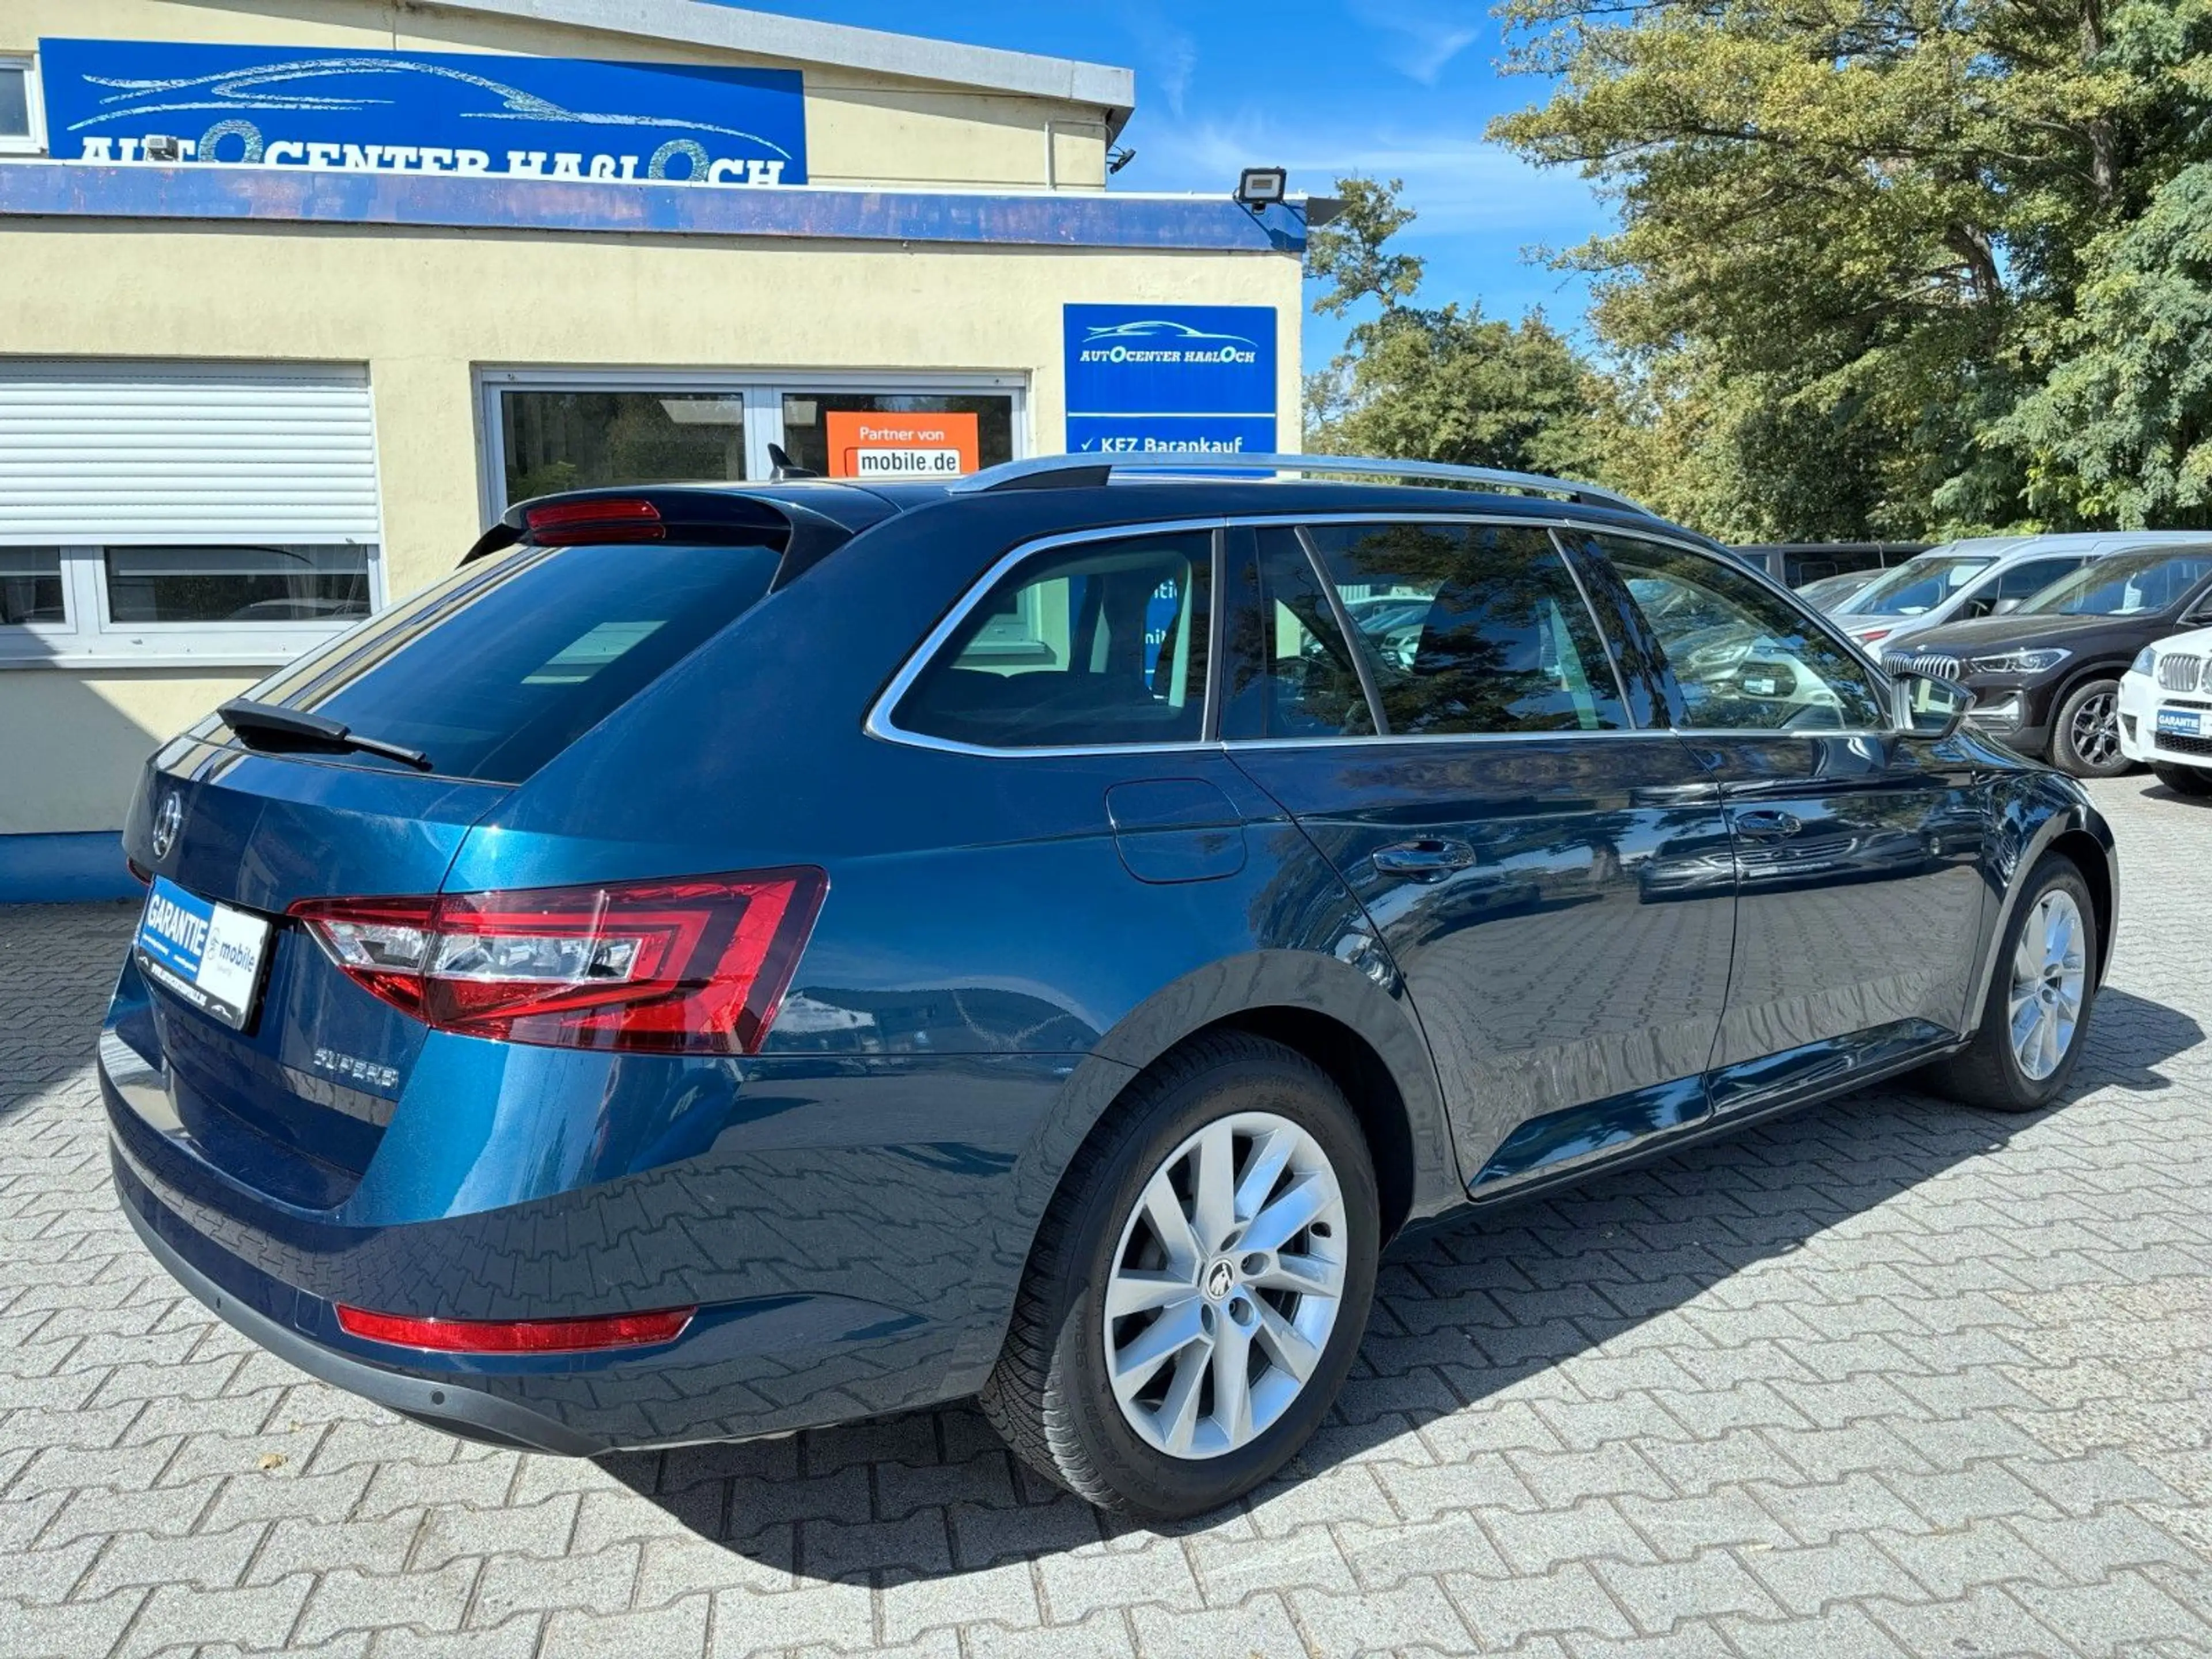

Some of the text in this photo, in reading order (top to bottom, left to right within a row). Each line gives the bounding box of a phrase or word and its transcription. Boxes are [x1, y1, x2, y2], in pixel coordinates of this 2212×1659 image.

[81, 119, 490, 172] ATOCENTER
[1080, 346, 1181, 363] AUTOCENTER
[860, 427, 944, 441] Partner von
[1101, 437, 1243, 453] KFZ Barankauf
[862, 452, 956, 471] mobile.de
[2158, 714, 2199, 728] GARANTIE
[147, 894, 209, 957] GARANTIE
[220, 941, 255, 972] mobile
